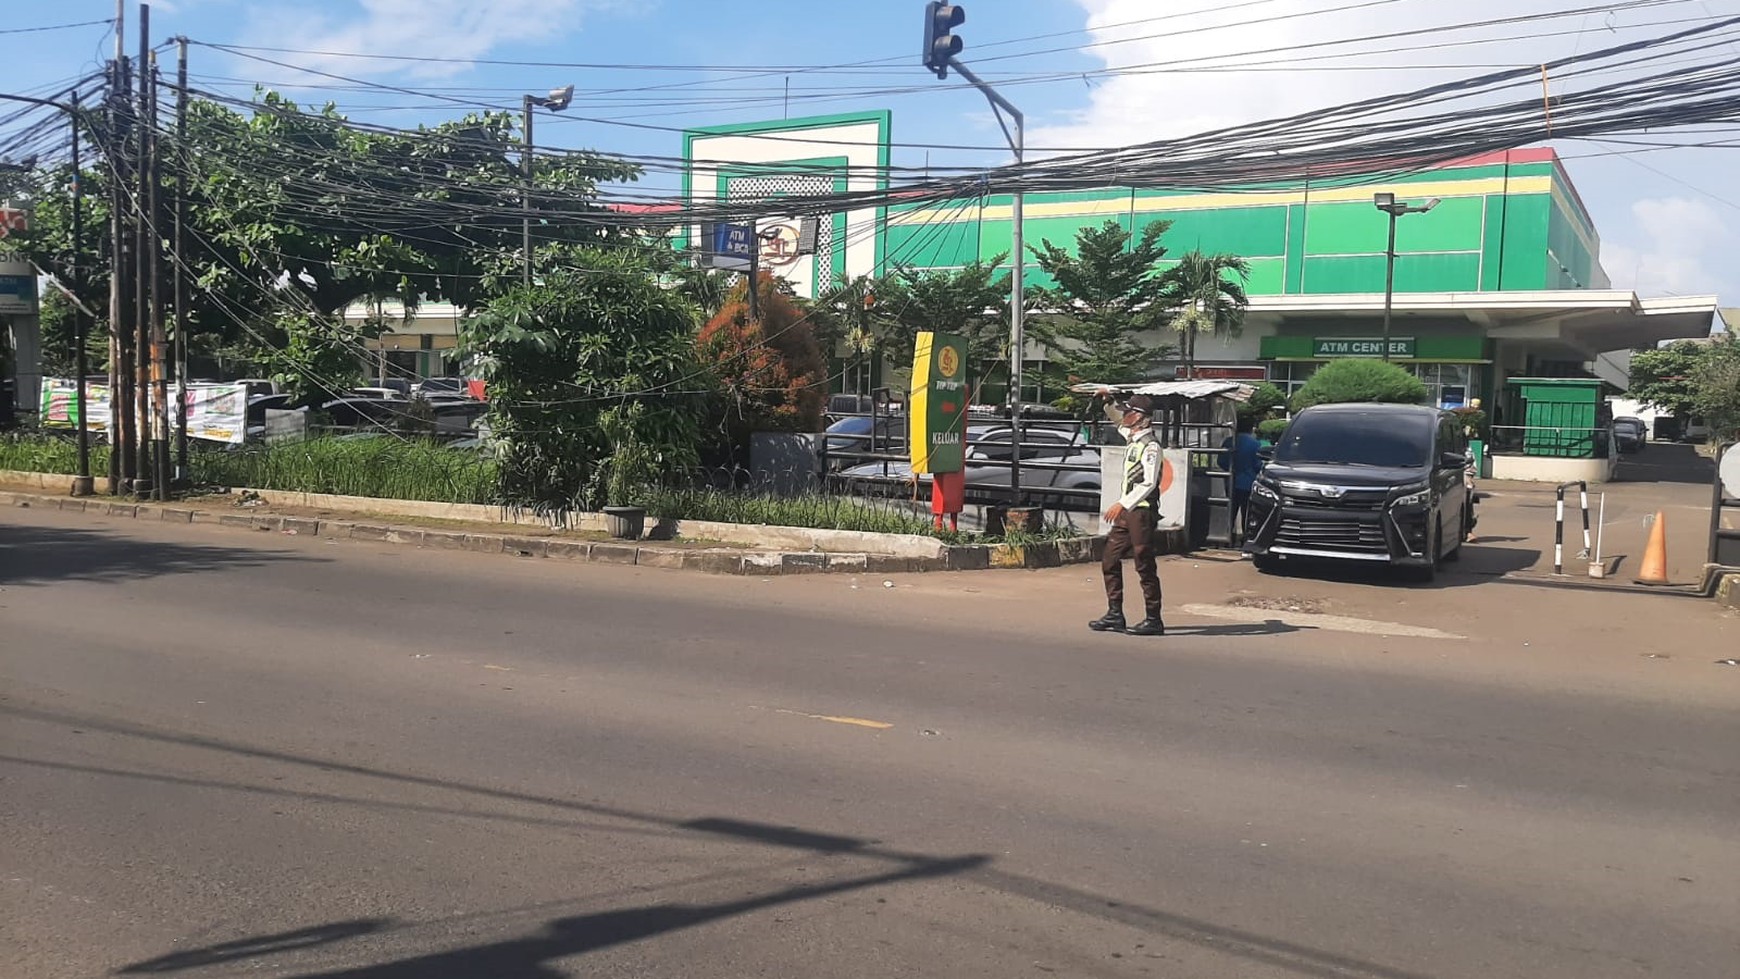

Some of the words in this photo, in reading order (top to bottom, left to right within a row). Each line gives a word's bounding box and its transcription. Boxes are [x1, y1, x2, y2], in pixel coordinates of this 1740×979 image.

[729, 230, 745, 241] ATM
[1320, 343, 1348, 353] ATM
[932, 431, 959, 444] KELUAR
